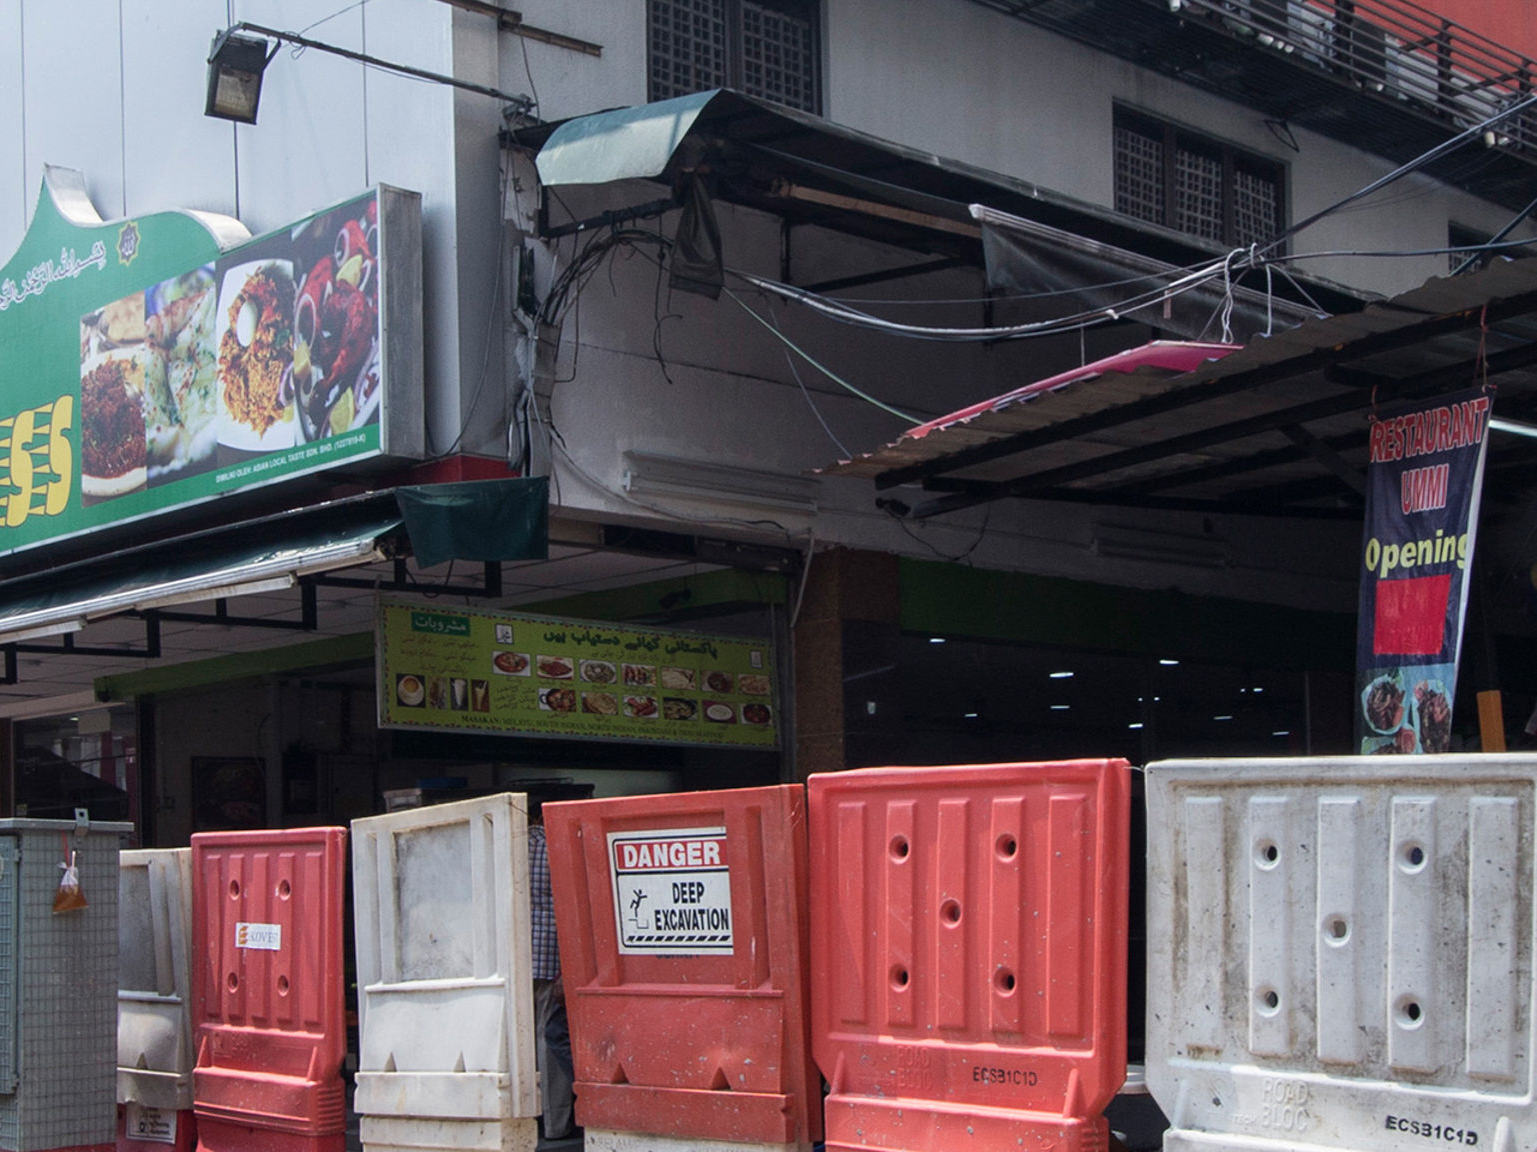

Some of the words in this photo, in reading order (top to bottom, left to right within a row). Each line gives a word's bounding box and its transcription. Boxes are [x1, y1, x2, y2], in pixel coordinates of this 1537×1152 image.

[1370, 396, 1489, 463] RESTAURANT
[1400, 463, 1451, 516] UMMI
[414, 615, 471, 634] مشروبات
[623, 840, 721, 869] DANGER
[672, 881, 705, 905] DEEP
[654, 907, 730, 932] EXCAVATION
[1262, 1077, 1310, 1105] ROAD
[1261, 1104, 1311, 1132] BLOC
